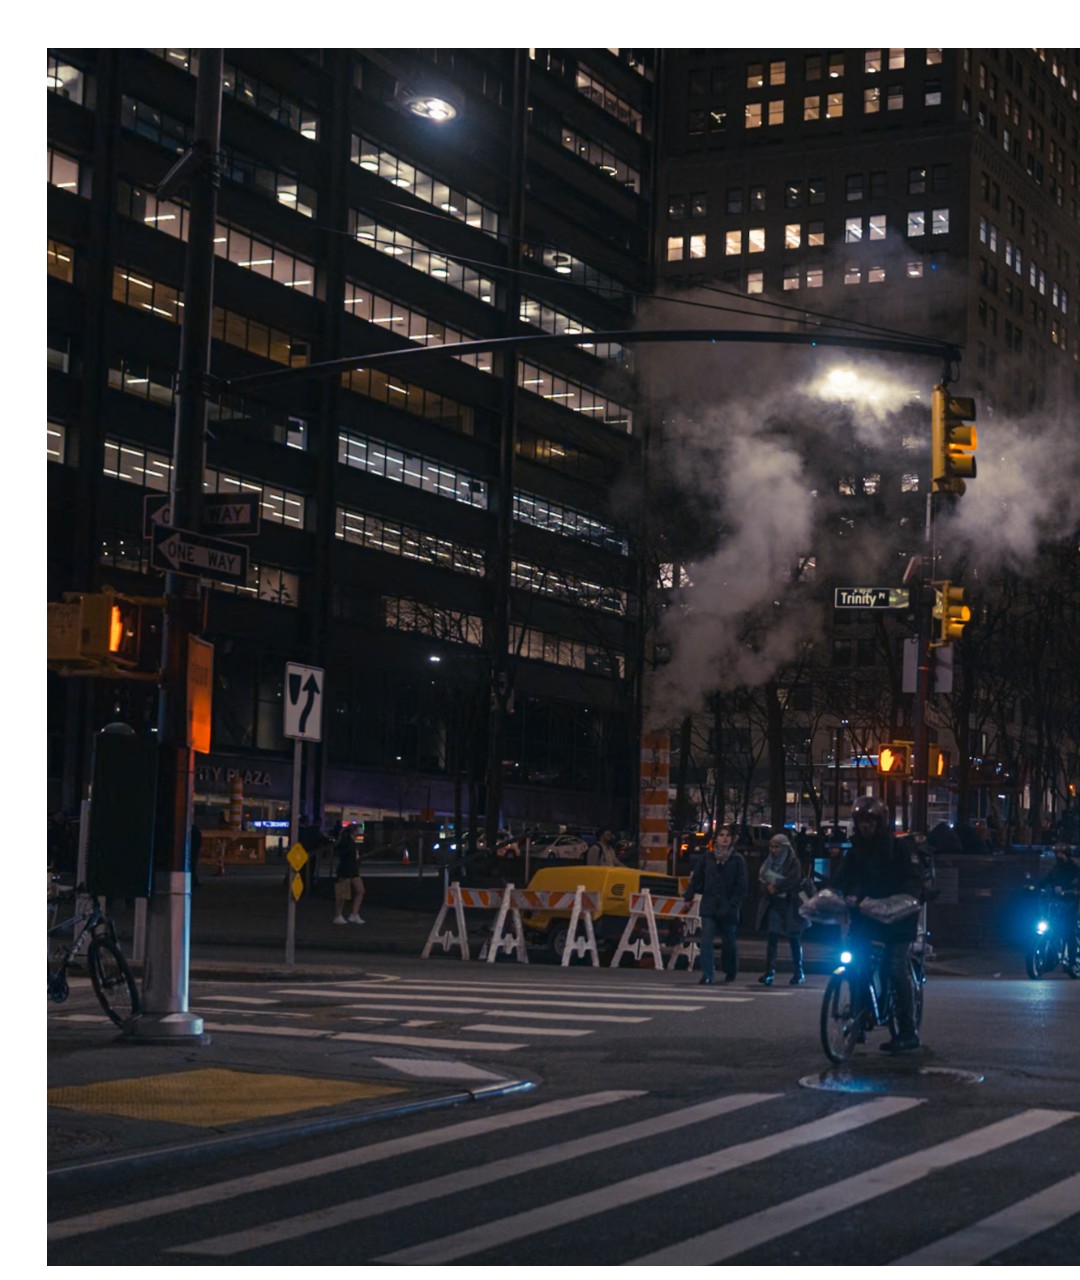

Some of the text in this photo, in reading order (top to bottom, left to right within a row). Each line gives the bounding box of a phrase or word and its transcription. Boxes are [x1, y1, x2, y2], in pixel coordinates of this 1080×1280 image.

[168, 541, 236, 572] ONE WAY
[840, 592, 876, 607] Trinity
[227, 767, 272, 787] PLAZA
